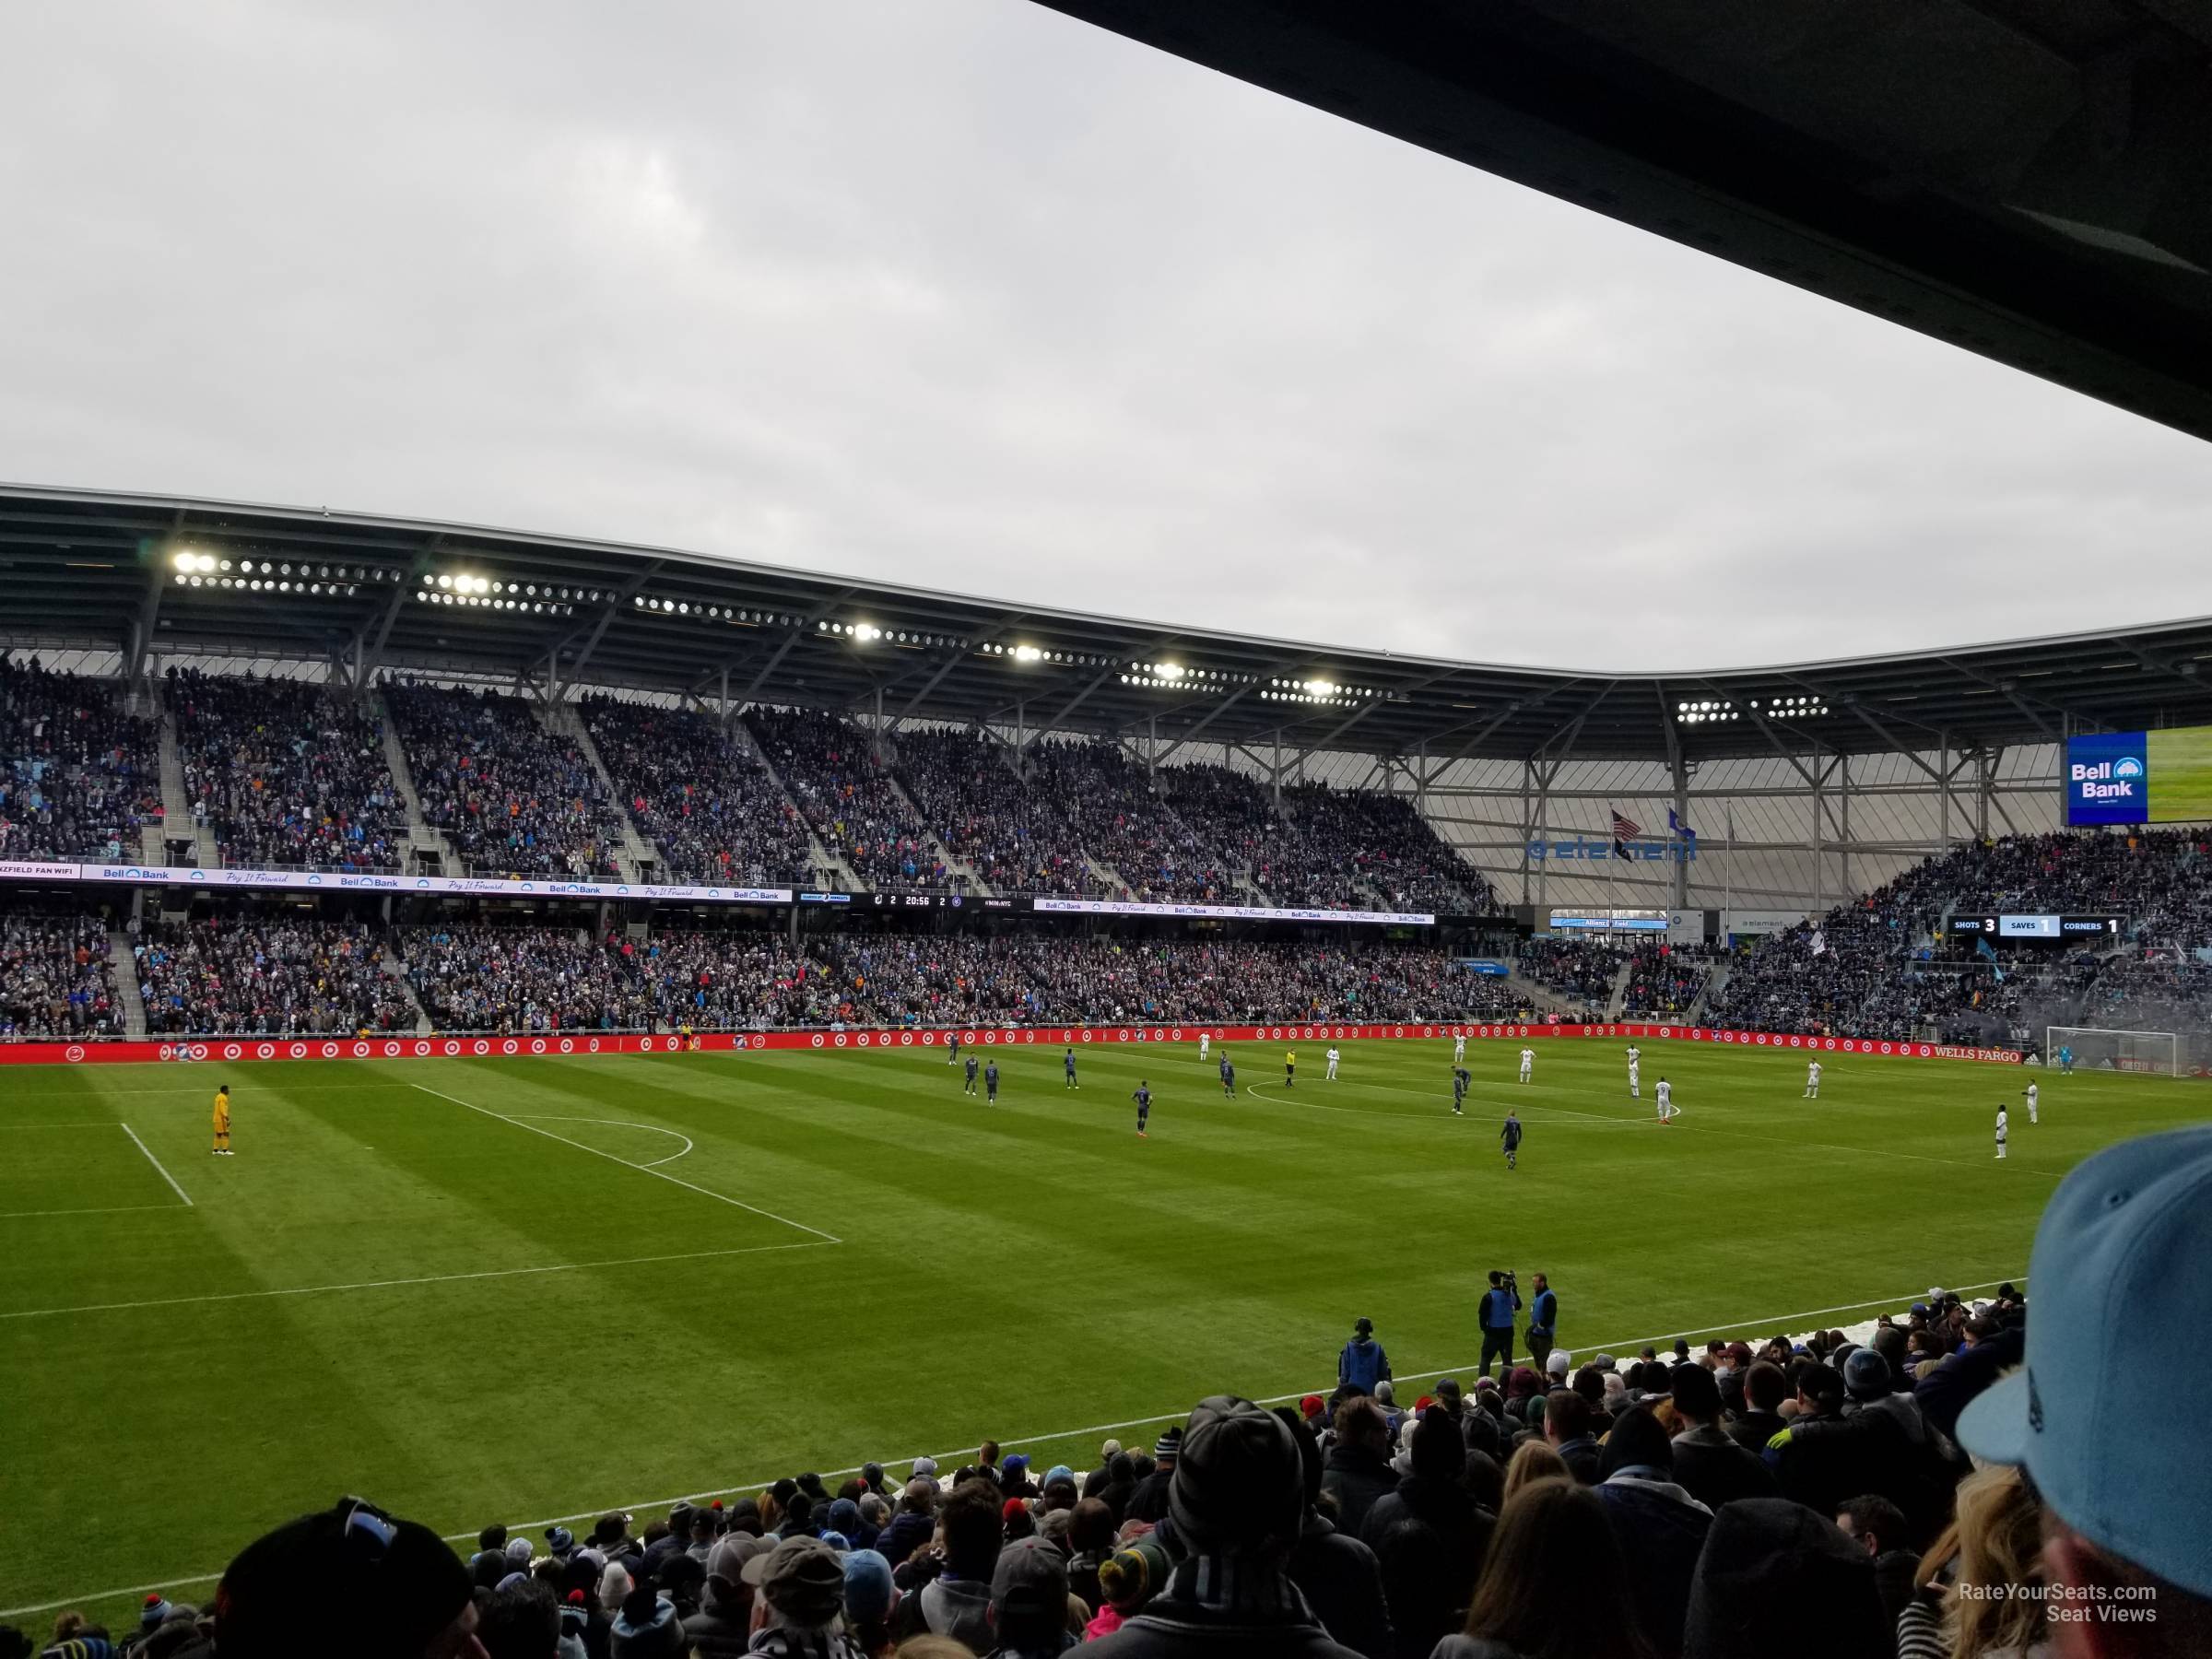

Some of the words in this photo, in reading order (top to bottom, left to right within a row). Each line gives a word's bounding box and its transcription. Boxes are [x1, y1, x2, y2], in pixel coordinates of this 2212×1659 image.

[2071, 762, 2111, 781] Bell
[2082, 781, 2133, 798] Bank
[103, 869, 124, 877] Bell
[142, 870, 169, 879] Bank
[226, 872, 244, 883] Pay
[245, 873, 254, 882] It
[254, 873, 288, 883] Forward
[341, 877, 359, 886] Bell
[374, 879, 398, 888] Bank
[448, 880, 463, 890] Pay
[464, 881, 475, 889] It
[475, 880, 504, 890] Forward
[644, 887, 658, 897] Pay
[659, 888, 666, 896] It
[666, 887, 693, 897] Forward
[890, 896, 896, 904] 2
[905, 897, 930, 905] 20:56
[939, 898, 946, 906] 2
[1112, 903, 1121, 912] Pay
[1984, 919, 1995, 933] 3
[2040, 919, 2050, 933] 1
[2108, 919, 2117, 933] 1
[1935, 1046, 1975, 1059] WELLS
[1977, 1049, 2019, 1063] FARGO
